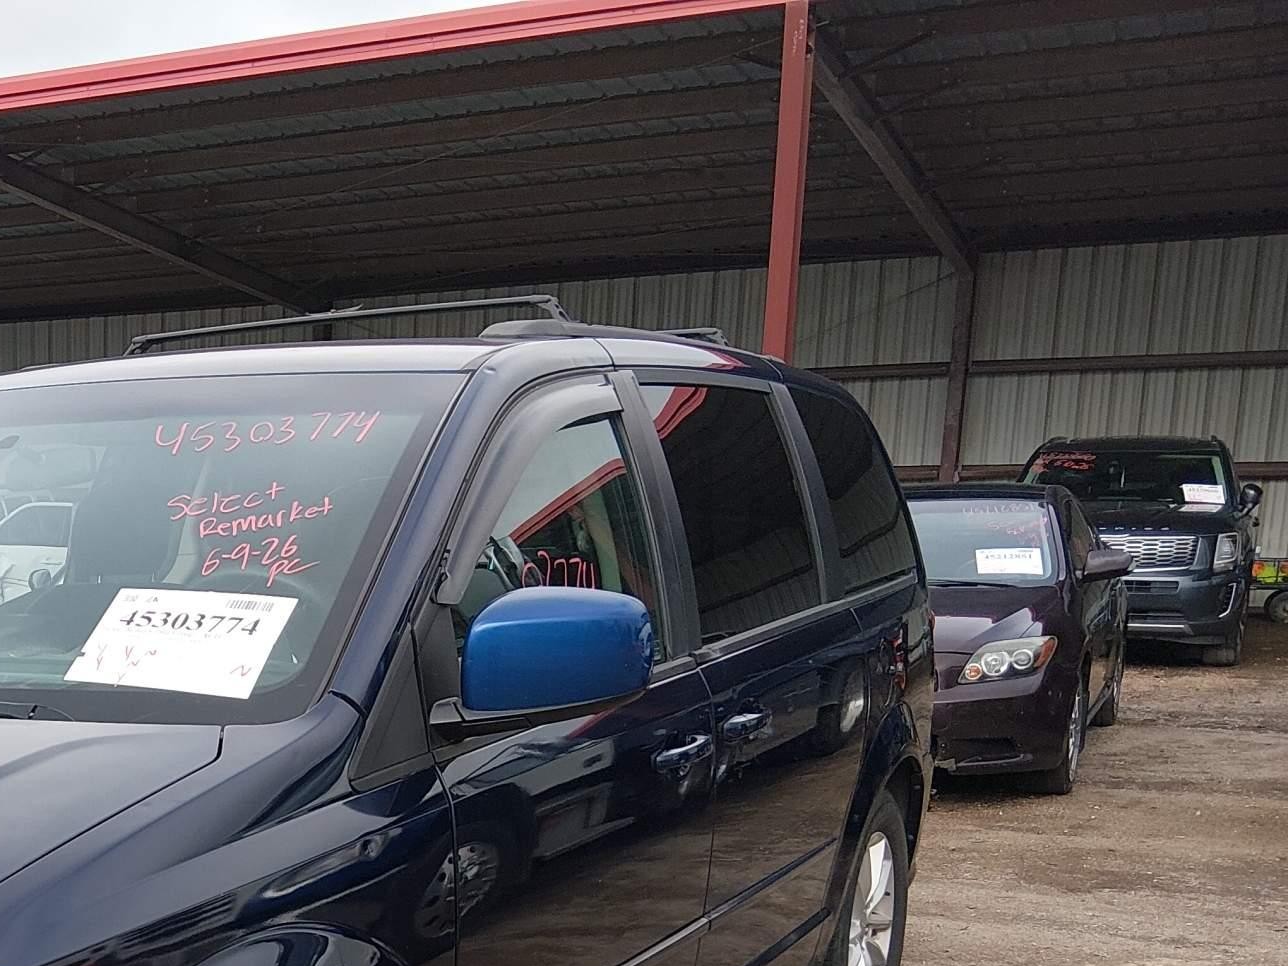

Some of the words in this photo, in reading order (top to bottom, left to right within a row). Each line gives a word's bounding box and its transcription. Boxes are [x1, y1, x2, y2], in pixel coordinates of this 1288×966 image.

[155, 411, 381, 455] 45303774
[199, 496, 333, 538] Remarket
[201, 534, 298, 577] 6-9-26
[119, 611, 261, 636] 45303774
